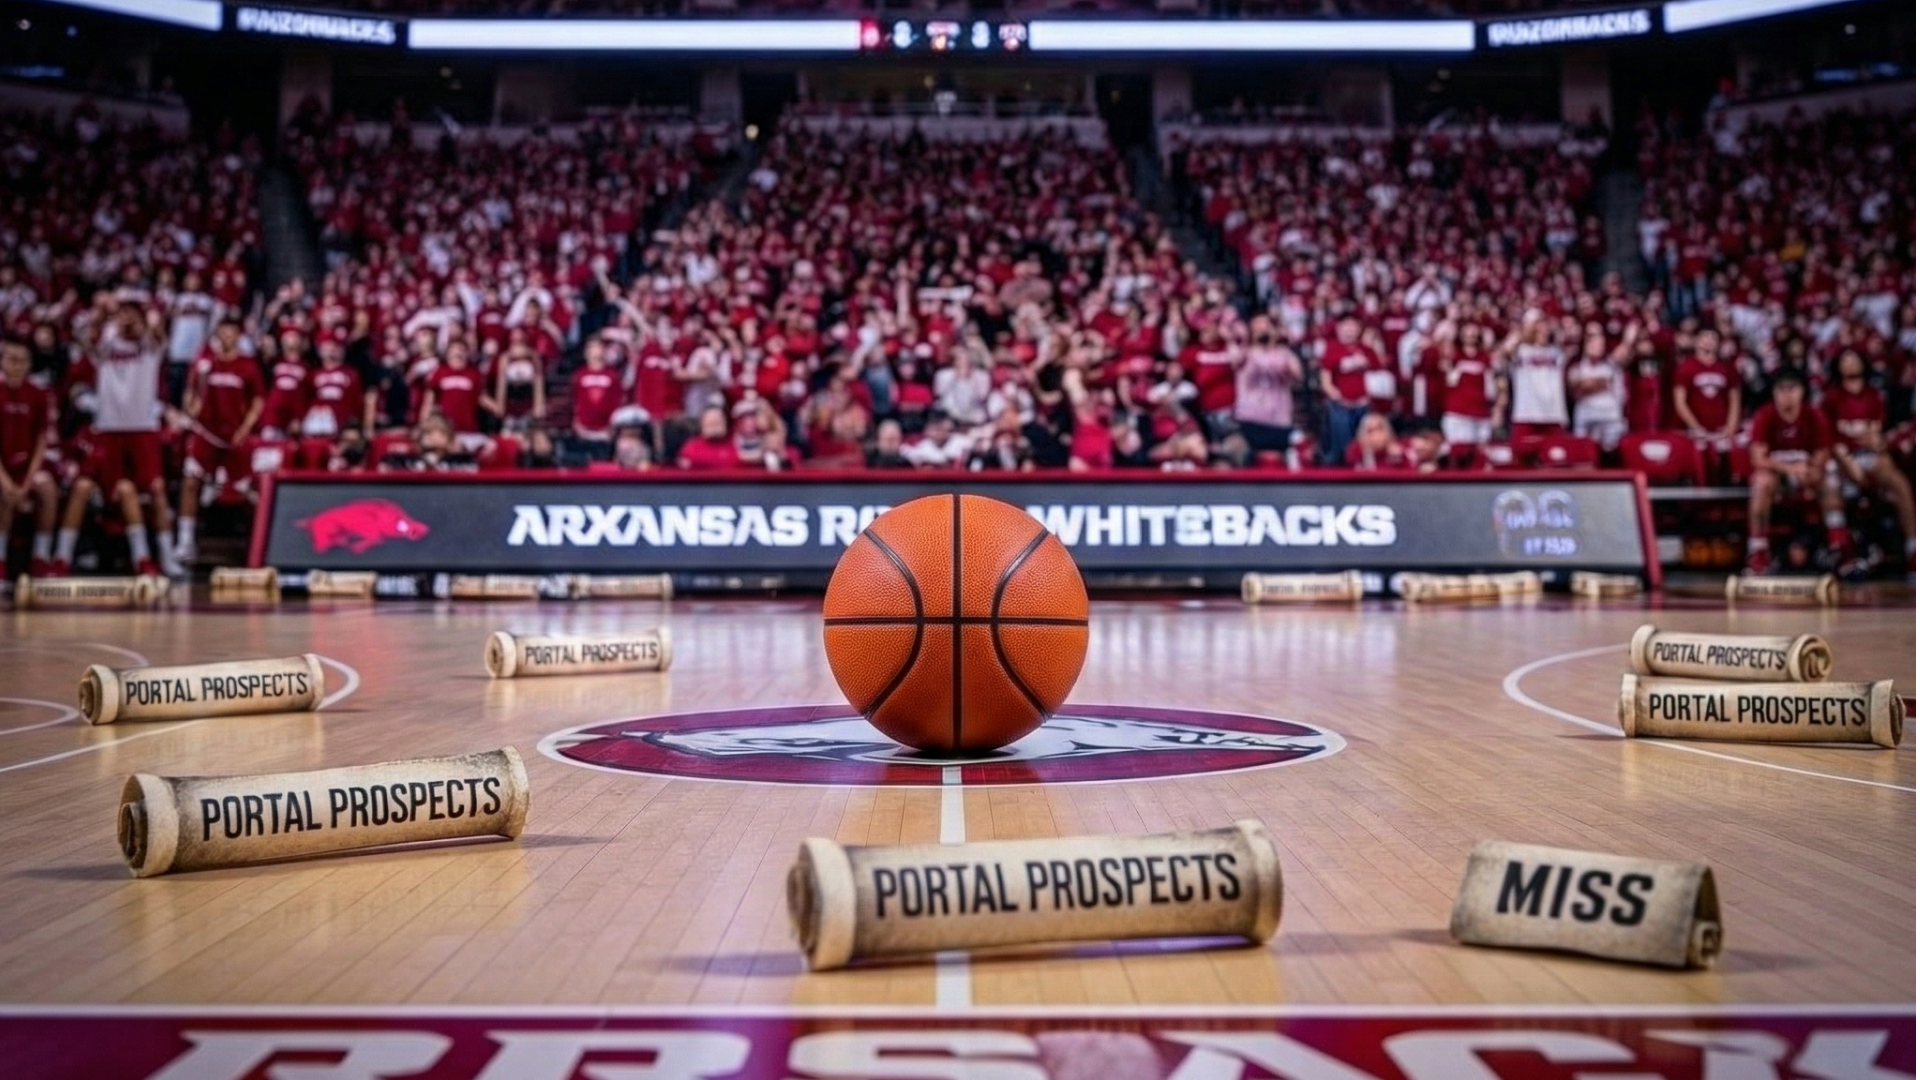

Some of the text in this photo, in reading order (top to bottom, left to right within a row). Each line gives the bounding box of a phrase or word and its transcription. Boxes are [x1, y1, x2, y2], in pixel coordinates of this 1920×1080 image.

[507, 505, 809, 547] ARXANSAS
[525, 642, 658, 665] PORTAL PROSPECTS
[1653, 642, 1787, 670] PORTAL PROSPECTS
[126, 672, 309, 706] PORTAL PROSPECTS
[1649, 693, 1867, 727] PORTAL PROSPECTS
[201, 776, 503, 842] PORTAL PROSPECTS
[872, 852, 1244, 920] PORTAL PROSPECTS
[1495, 860, 1655, 927] MISS
